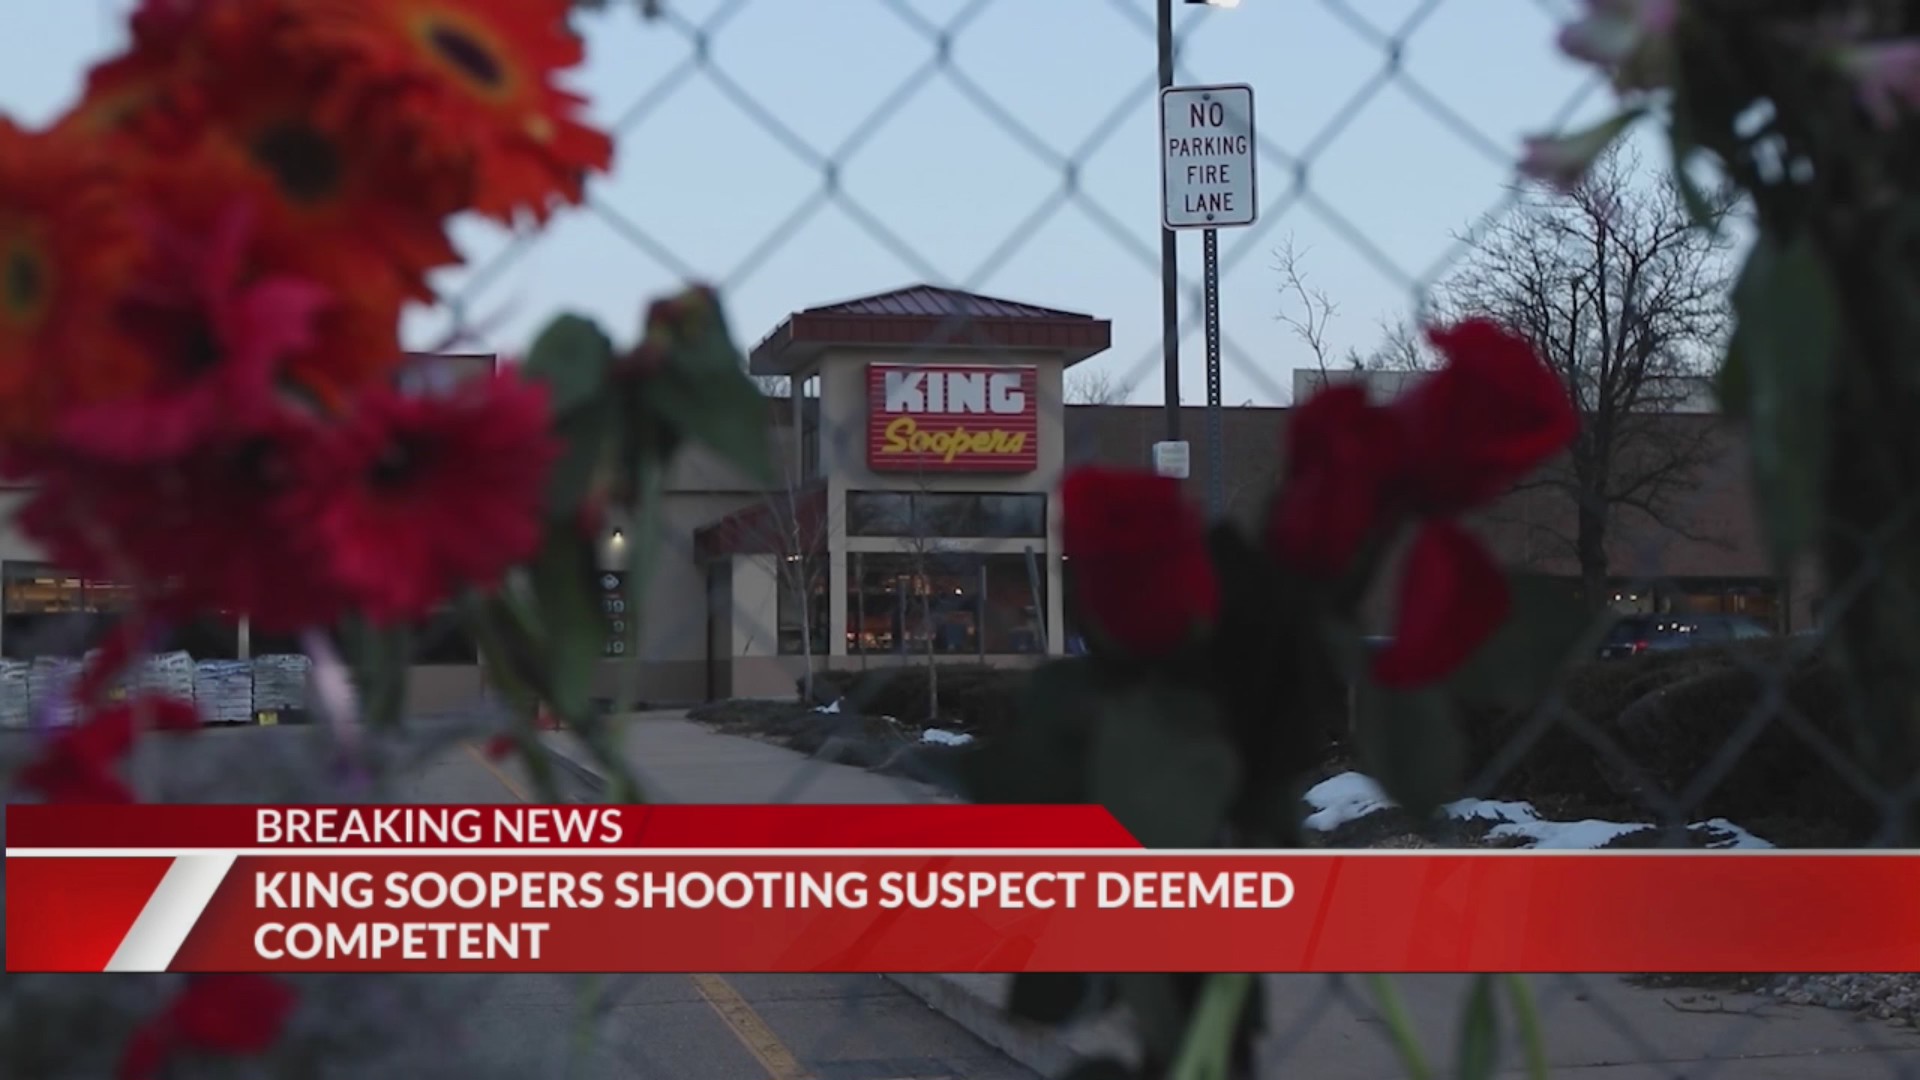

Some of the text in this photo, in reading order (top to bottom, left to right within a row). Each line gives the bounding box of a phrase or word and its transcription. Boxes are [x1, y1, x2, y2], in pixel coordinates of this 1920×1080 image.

[1189, 102, 1224, 128] NO
[1169, 135, 1248, 156] PARKING
[1187, 164, 1231, 184] FIRE
[1184, 192, 1234, 213] LANE
[885, 371, 1025, 413] KING
[880, 416, 1027, 463] Soopers
